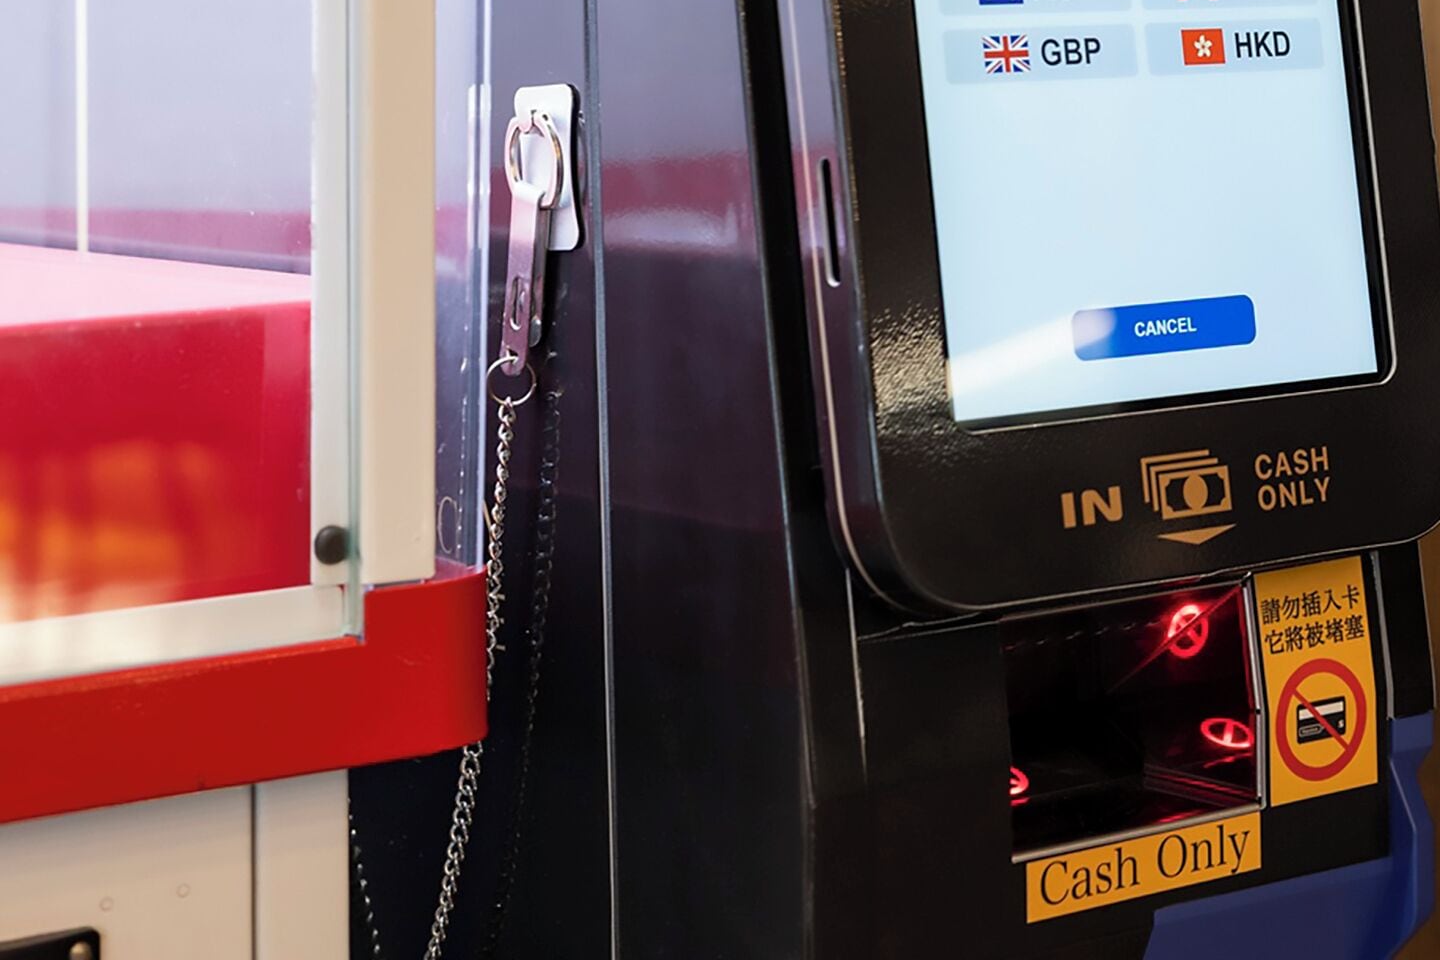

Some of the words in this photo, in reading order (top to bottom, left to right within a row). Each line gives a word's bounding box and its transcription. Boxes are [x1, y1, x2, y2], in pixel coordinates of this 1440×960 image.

[1040, 37, 1101, 68] GBP
[1234, 30, 1291, 59] HKD
[1134, 316, 1198, 338] CANCEL
[1254, 445, 1331, 480] CASH
[1060, 485, 1125, 529] IN
[1257, 477, 1331, 512] ONLY
[1260, 584, 1361, 626] 請勿插入卡
[1264, 613, 1365, 656] 它將被堵塞
[1040, 847, 1141, 906] Cash
[1157, 824, 1251, 879] Only
